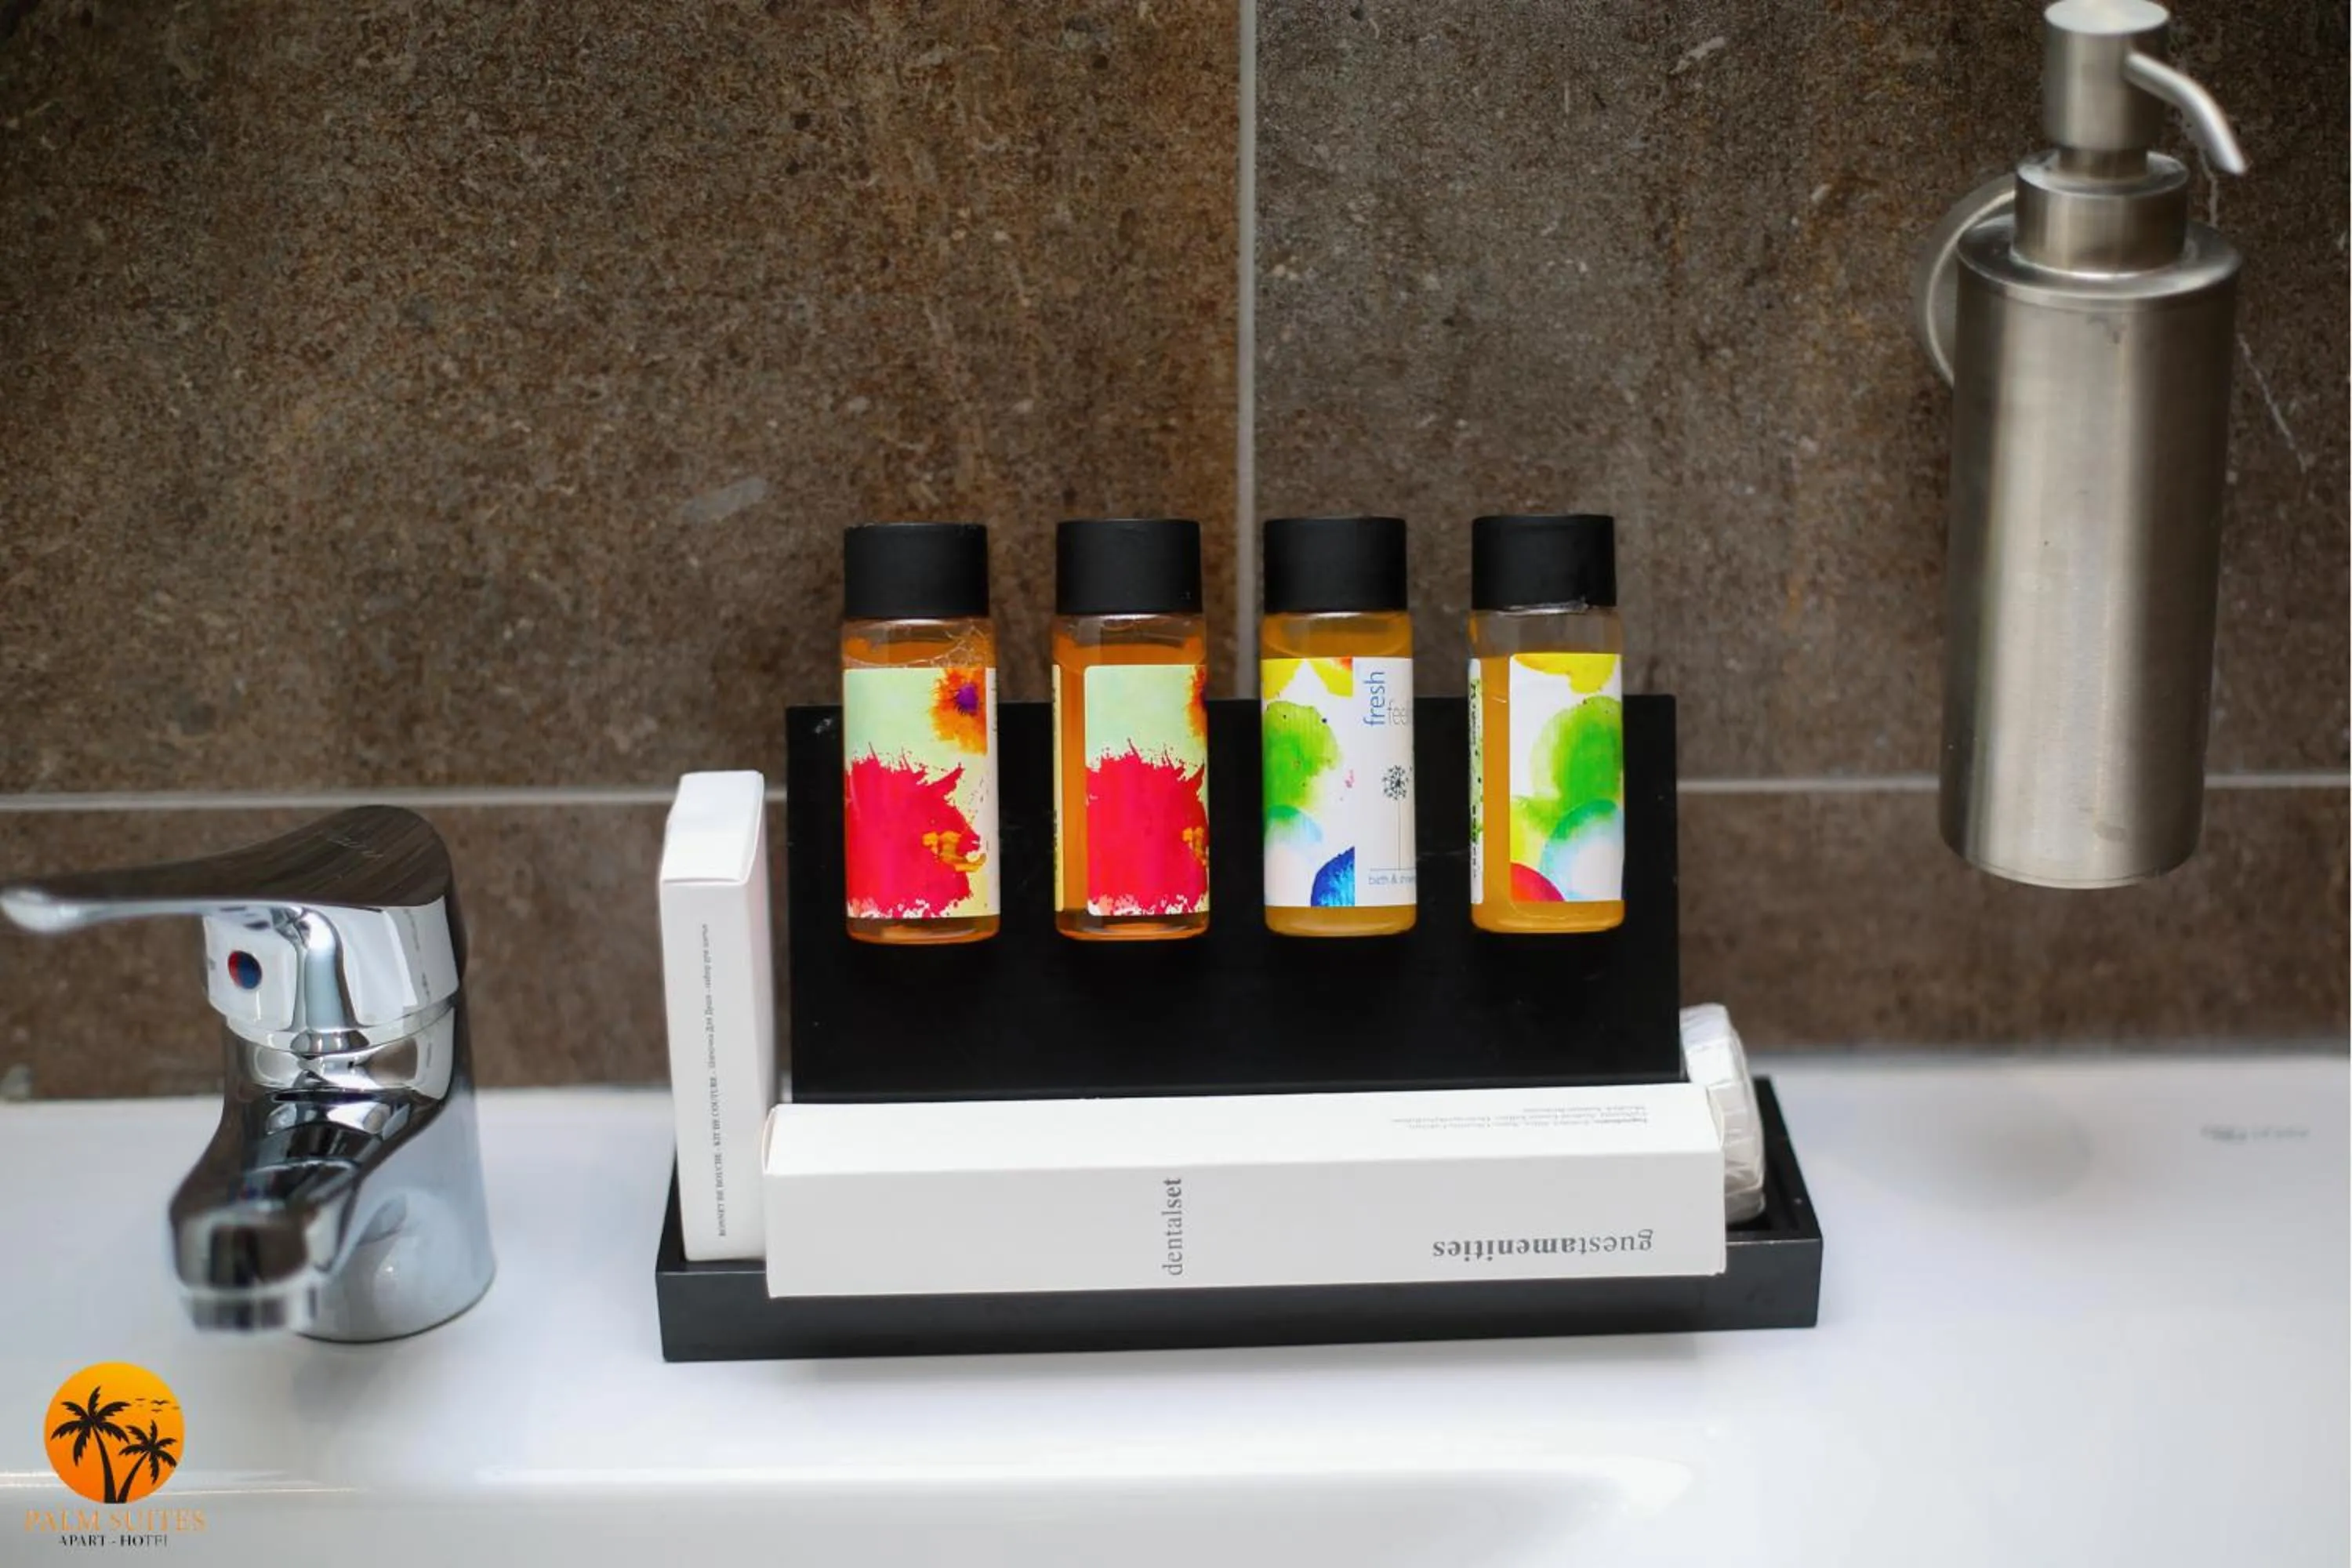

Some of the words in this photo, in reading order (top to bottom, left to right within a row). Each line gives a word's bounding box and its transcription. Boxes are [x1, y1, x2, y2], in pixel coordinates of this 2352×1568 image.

[1363, 671, 1385, 726] fresh
[1161, 1178, 1183, 1276] dentalset
[1432, 1229, 1653, 1262] guestamenities
